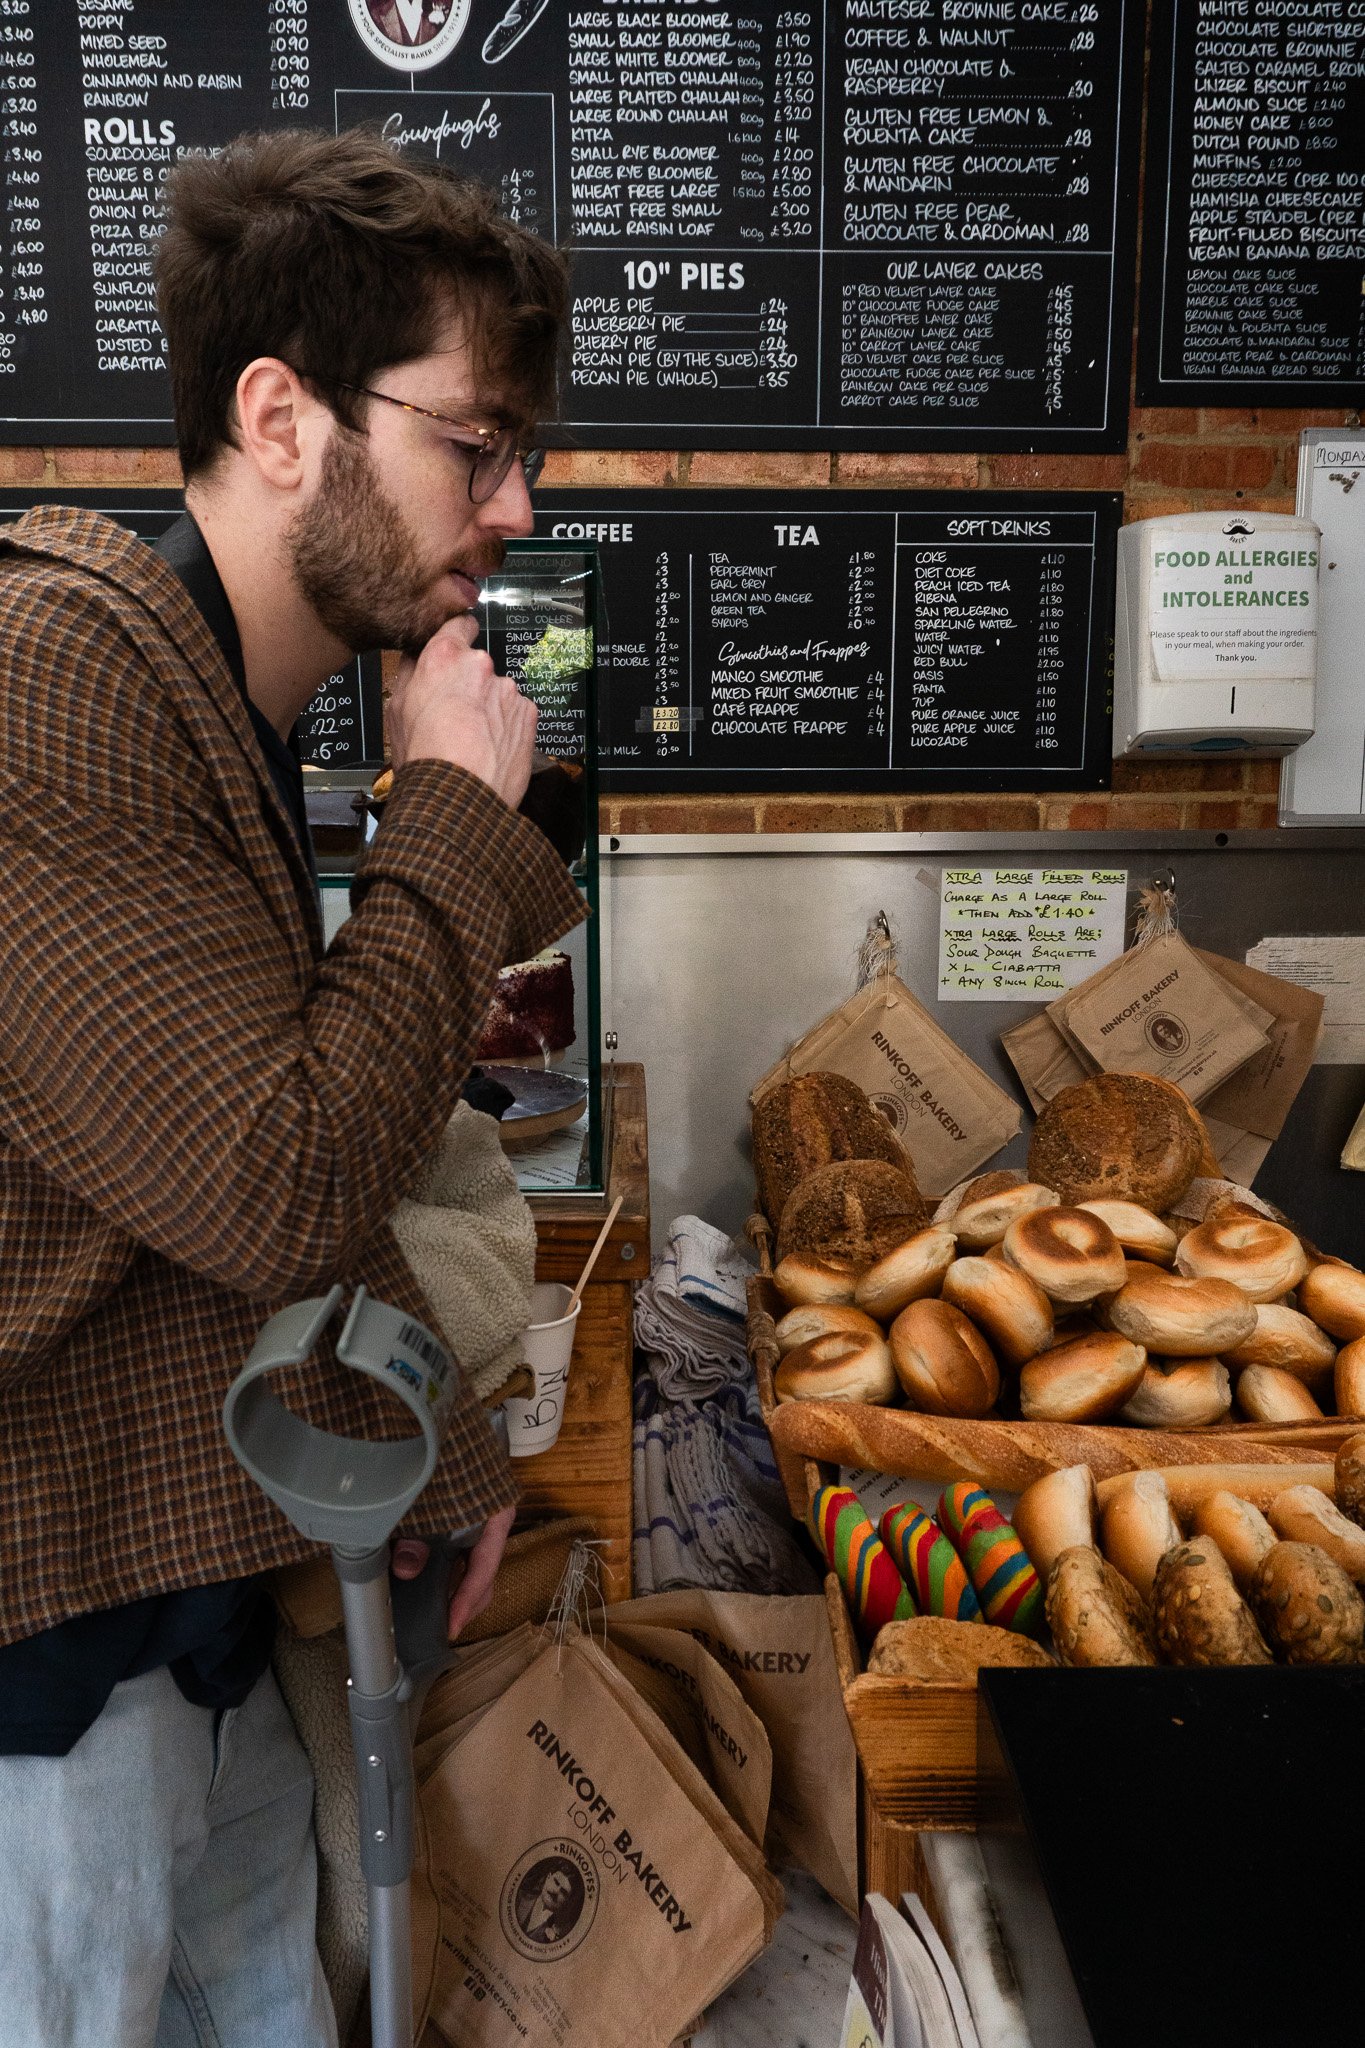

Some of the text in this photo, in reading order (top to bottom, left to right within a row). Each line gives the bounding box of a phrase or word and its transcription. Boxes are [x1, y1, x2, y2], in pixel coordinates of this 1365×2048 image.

[845, 0, 935, 20] MALTESER
[942, 2, 1016, 20] BROWNIE
[1021, 2, 1069, 20] CAKE
[78, 15, 123, 31] POPPY
[568, 33, 616, 48] SMALL
[619, 33, 662, 48] BLACK
[668, 33, 736, 48] BLOOMER
[776, 32, 810, 48] £1.90
[845, 28, 910, 48] COFFEE
[917, 28, 932, 46] &
[940, 29, 1015, 46] WALNUT
[374, 37, 408, 59] SPECIALIST
[411, 49, 433, 59] BAKER
[82, 55, 168, 68] WHOLEMEAL
[568, 52, 610, 67] LARGE
[616, 53, 659, 67] WHITE
[664, 53, 732, 67] BLOOMER
[775, 53, 813, 67] £2.20
[83, 74, 242, 89] CINNAMON AND RAISIN
[1195, 79, 1247, 93] LINZER
[1254, 80, 1312, 93] BISCUIT
[83, 93, 149, 107] RAINBOW
[1194, 116, 1244, 130] HONEY
[1250, 116, 1291, 130] CAKE
[84, 119, 176, 145] ROLLS
[571, 127, 800, 143] KITKA £14
[88, 186, 148, 201] CHALLAH
[90, 224, 132, 239] PIZZA
[624, 261, 745, 291] 10" PIES
[887, 261, 1044, 280] OUR LAYER CAKES
[1187, 269, 1297, 280] LEMON CAKE SLICE
[858, 284, 880, 297] RED
[884, 286, 926, 297] VELVET
[929, 286, 963, 297] LAYER
[968, 287, 997, 297] CAKE
[96, 319, 162, 333] CIABATTA
[573, 316, 788, 334] BLUEBERRY PIE £24
[572, 353, 622, 366] PECAN
[629, 353, 652, 366] PIE
[683, 353, 711, 366] THE
[552, 523, 633, 542] COFFEE
[774, 525, 820, 546] TEA
[947, 520, 1051, 536] SOFT DRINKS
[1155, 550, 1318, 568] FOOD ALLERGIES
[710, 566, 777, 577] PEPPERMINT
[915, 567, 943, 578] DIET
[945, 567, 976, 578] COKE
[1224, 571, 1253, 584] and
[711, 579, 766, 590] EARL GREY
[711, 593, 814, 603] LEMON AND GINGER
[915, 593, 957, 604] RIBENA
[1163, 590, 1310, 608] INTOLERANCES
[1177, 631, 1199, 639] speak
[719, 640, 870, 666] Smoothies and Frappes
[1174, 642, 1191, 650] your
[1193, 641, 1214, 649] meal,
[1238, 641, 1265, 650] making
[1241, 655, 1257, 663] you.
[711, 670, 884, 685] MANGO SMOOTHIE £4
[713, 701, 799, 716] CAFÉ FRAPPE
[912, 697, 935, 707] 7UP
[911, 738, 968, 748] LUCOZADE
[946, 872, 982, 881] XTRA
[995, 872, 1033, 881] LARGE
[1092, 871, 1125, 881] ROLLS
[944, 891, 984, 903] CHARGE
[992, 893, 1008, 902] AS
[1035, 892, 1072, 902] LARGE
[1080, 891, 1107, 901] ROLL
[1008, 909, 1033, 918] ADD
[945, 929, 972, 938] XTRA
[982, 928, 1017, 938] LARGE
[1028, 925, 1065, 938] ROLLS
[946, 943, 1097, 961] SOUR DOUGH BAGUETTE
[992, 961, 1061, 972] CIABATTA
[958, 975, 1064, 988] ANY ROLL
[1100, 969, 1180, 1036] RINKOFF BAKERY
[1132, 997, 1162, 1024] LONDON
[871, 1030, 967, 1142] RINKOFF BAKERY
[890, 1075, 928, 1118] LONDON
[718, 1641, 811, 1674] BAKERY
[526, 1719, 692, 1934] RINKOFF BAKERY
[566, 1800, 629, 1885] LONDON
[560, 1843, 595, 1893] RINKOFFS
